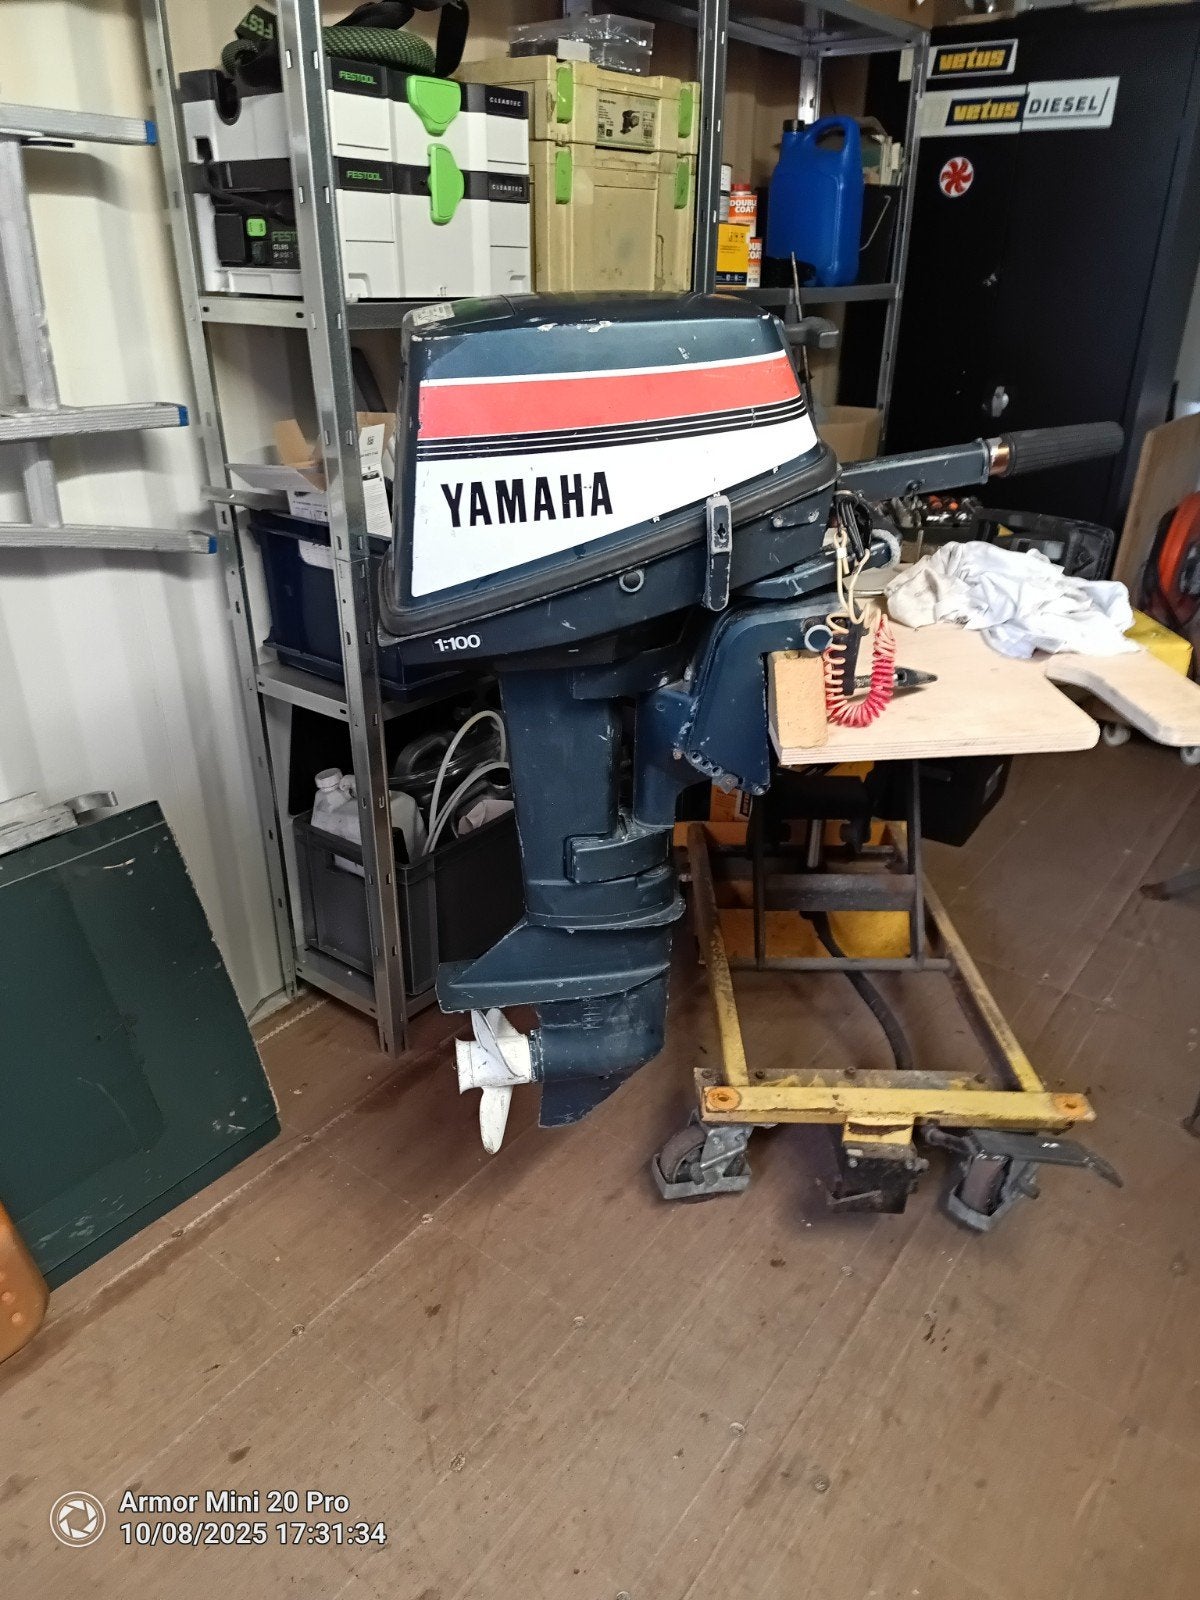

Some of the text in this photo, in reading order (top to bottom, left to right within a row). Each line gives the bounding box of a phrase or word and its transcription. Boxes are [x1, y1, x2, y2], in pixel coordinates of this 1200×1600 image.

[939, 48, 1006, 71] vetus
[339, 70, 377, 85] FESTOOL
[953, 95, 1098, 122] vetus DIESEL
[346, 170, 383, 181] FESTOOL
[440, 471, 613, 528] YAMAHA
[434, 634, 481, 652] 1:100
